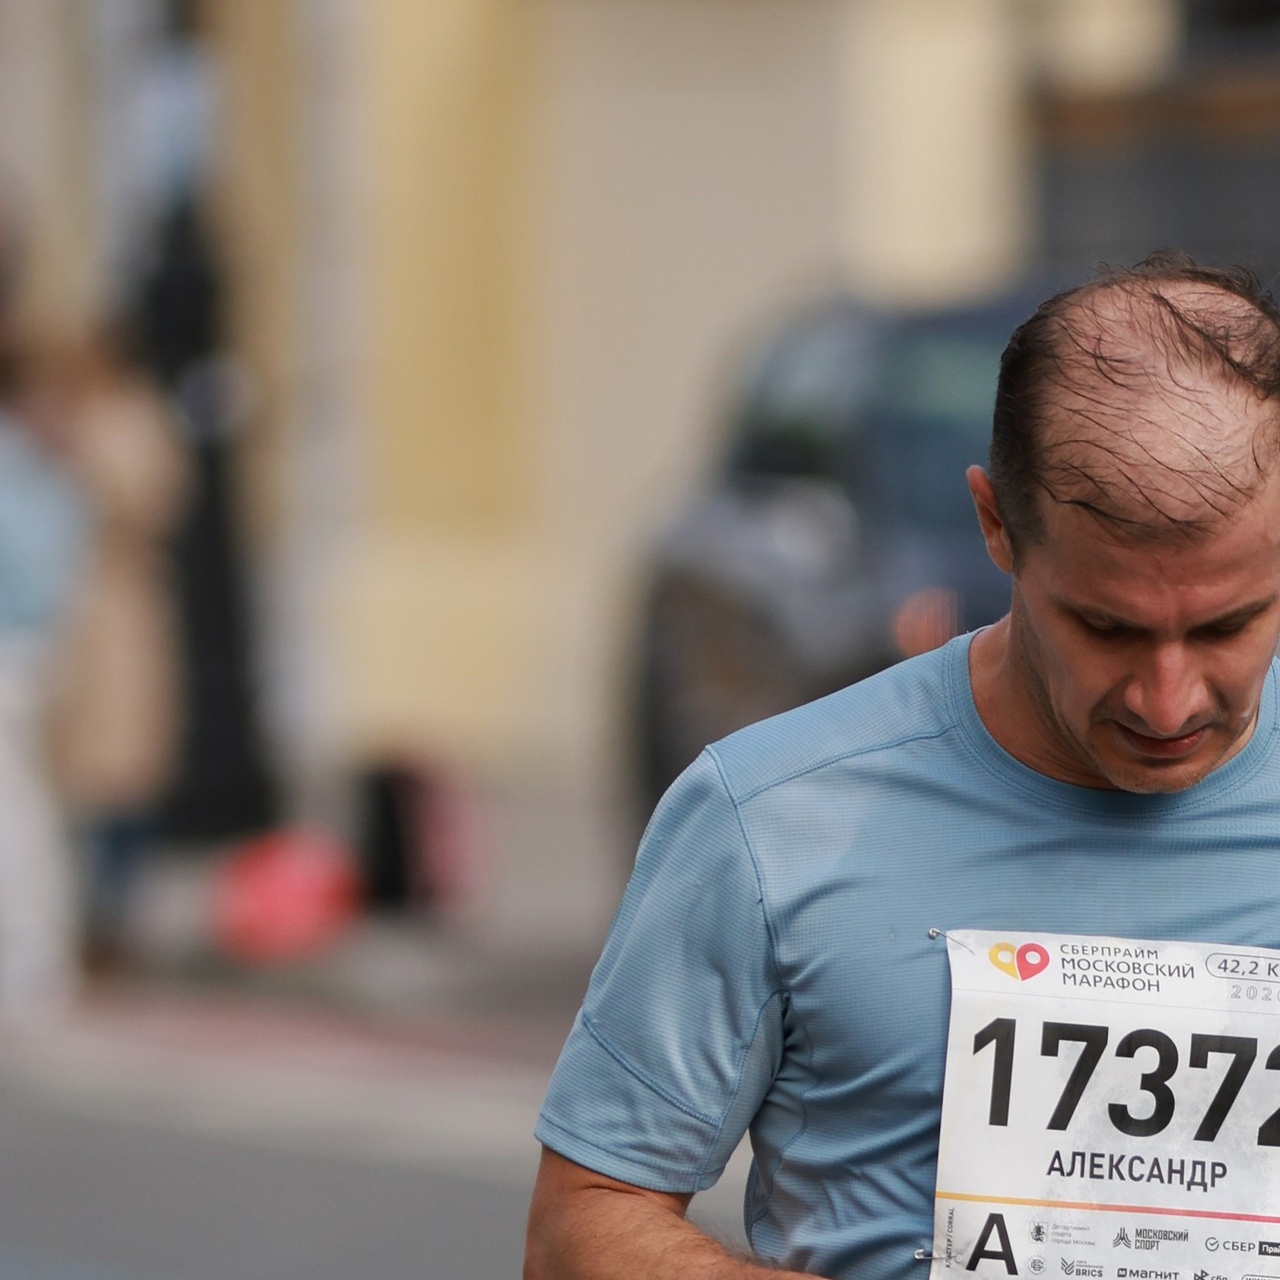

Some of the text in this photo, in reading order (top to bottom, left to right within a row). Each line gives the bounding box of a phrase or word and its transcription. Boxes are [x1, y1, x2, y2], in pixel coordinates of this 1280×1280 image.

[1060, 944, 1159, 959] СБЕРПРАЙМ
[1061, 957, 1195, 979] МОСКОВСКИЙ
[1217, 958, 1259, 976] 42,2
[1063, 973, 1160, 992] МАРАФОН
[1046, 1150, 1228, 1192] АЛЕКСАНДР
[1135, 1228, 1189, 1242] МОСКОВСКИЙ
[1134, 1239, 1160, 1251] СПОРТ
[1222, 1240, 1256, 1252] СБЕР
[1075, 1268, 1103, 1278] BRICS
